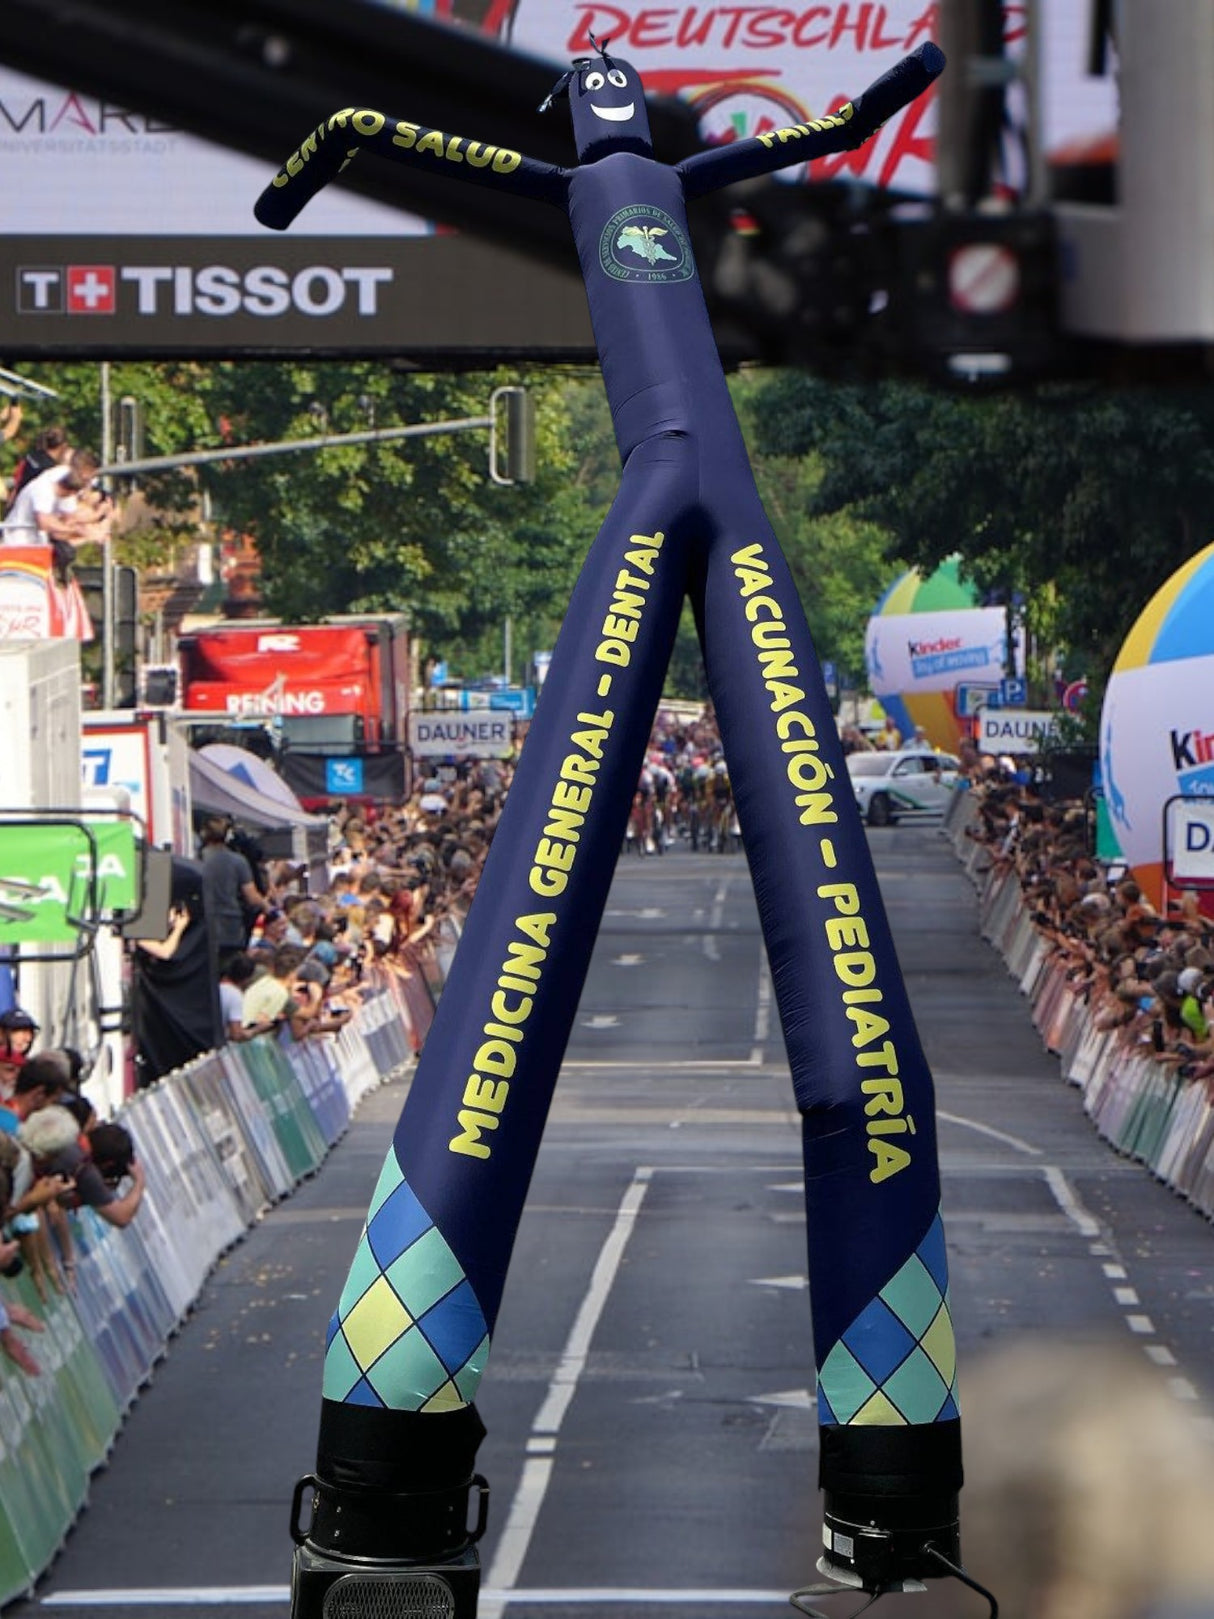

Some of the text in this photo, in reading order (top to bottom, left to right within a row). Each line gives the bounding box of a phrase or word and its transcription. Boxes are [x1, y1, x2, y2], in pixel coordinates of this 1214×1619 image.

[392, 121, 523, 174] SALUD
[121, 266, 394, 316] TISSOT
[1006, 681, 1021, 698] P
[417, 723, 505, 742] DAUNER
[986, 721, 1057, 738] DAUNE
[448, 912, 557, 1160] MEDICINA
[529, 711, 615, 897] GENERAL
[595, 531, 665, 668] DENTAL
[731, 543, 839, 826] VACUNACIÓN
[816, 883, 917, 1185] PEDIATRÍA
